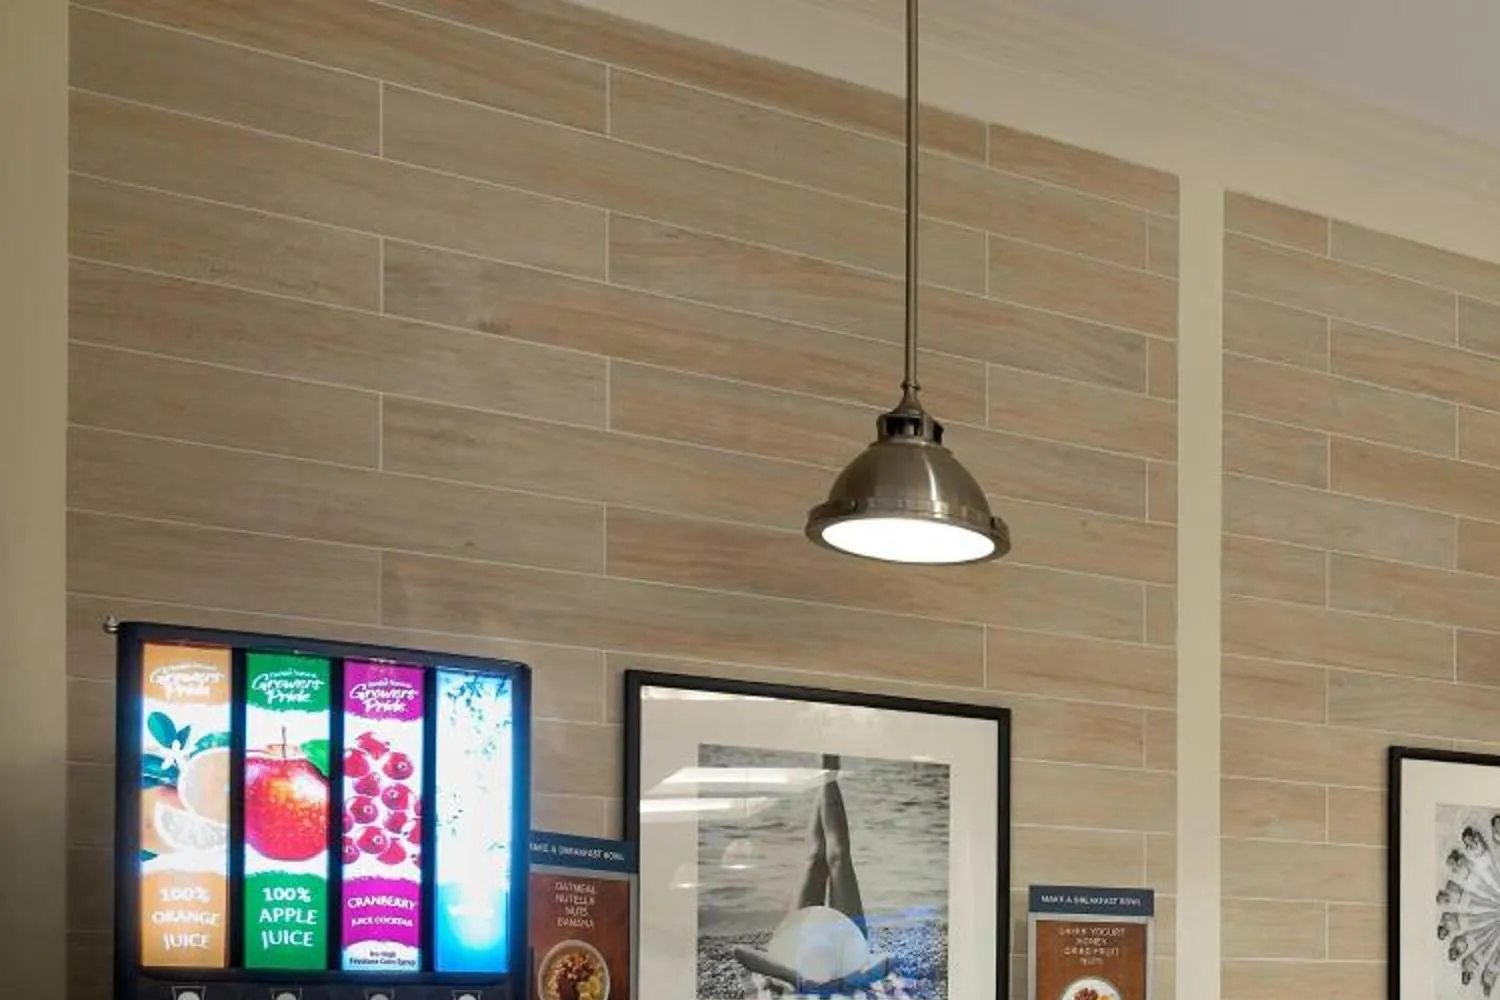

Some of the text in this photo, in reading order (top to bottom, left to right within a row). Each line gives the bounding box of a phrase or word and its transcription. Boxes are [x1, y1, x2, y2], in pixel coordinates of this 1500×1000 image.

[159, 886, 210, 903] 100%
[263, 886, 312, 903] 100%
[555, 881, 596, 894] OATMEAL
[347, 895, 417, 911] CRANBERRY
[151, 910, 221, 927] ORANGE
[259, 907, 319, 925] APPLE
[163, 931, 210, 950] JUICE
[260, 929, 315, 949] JUICE
